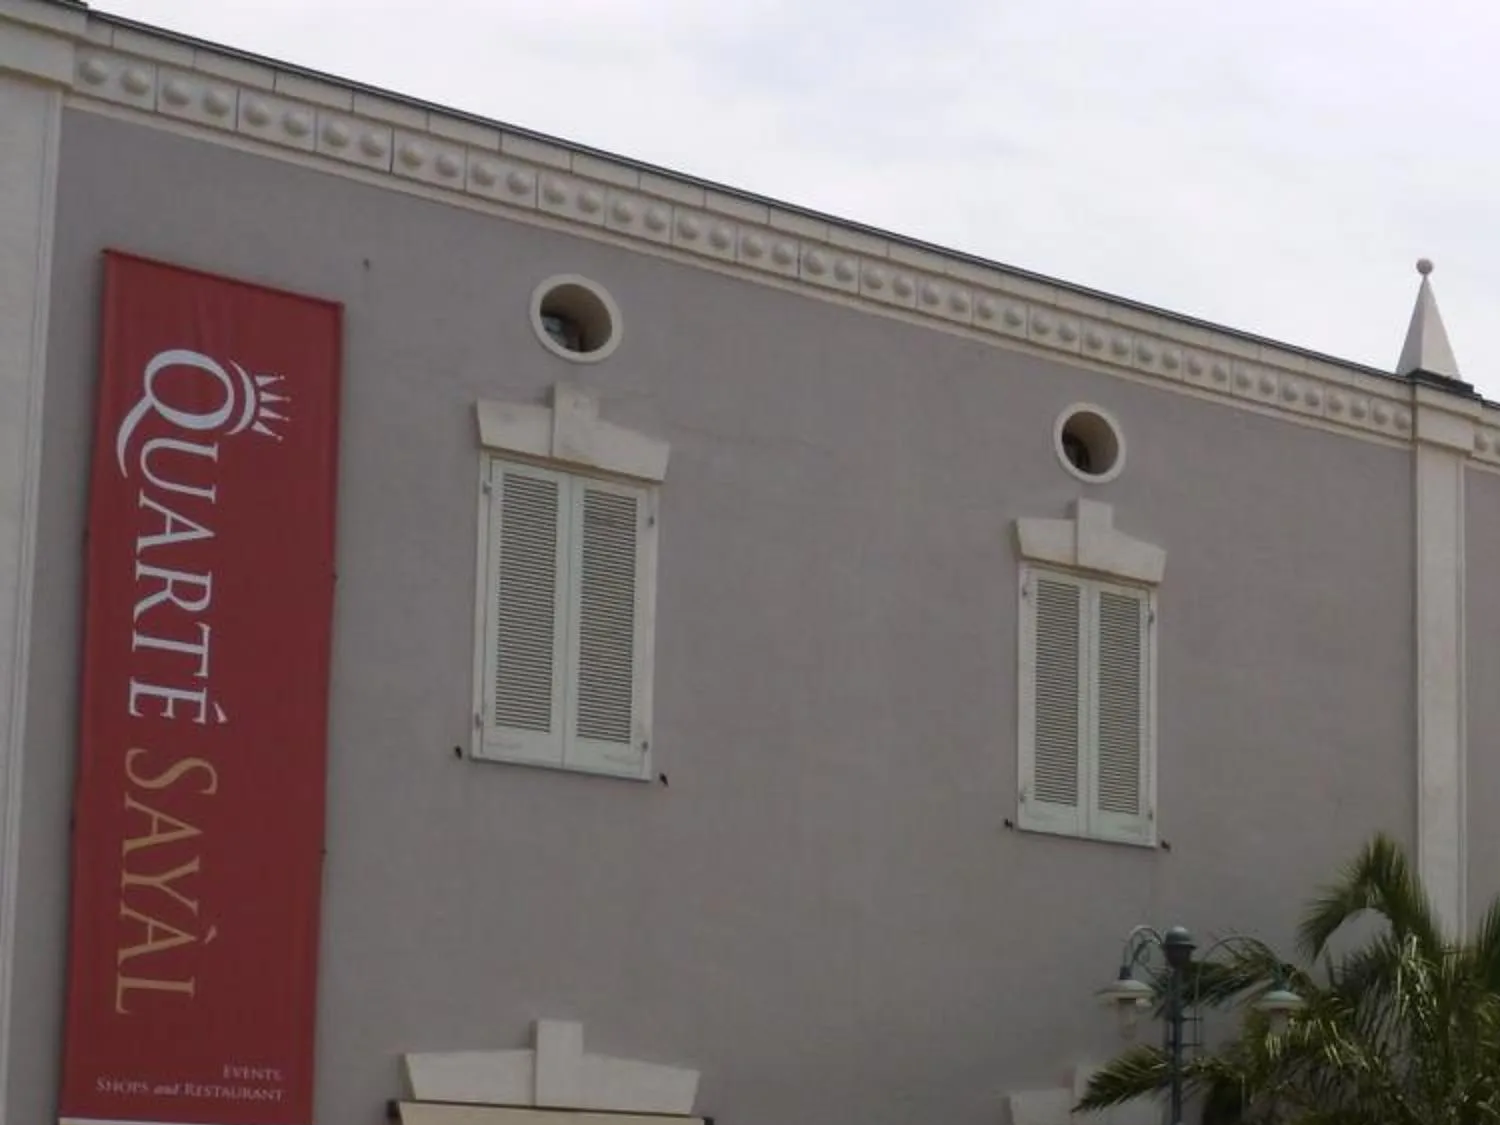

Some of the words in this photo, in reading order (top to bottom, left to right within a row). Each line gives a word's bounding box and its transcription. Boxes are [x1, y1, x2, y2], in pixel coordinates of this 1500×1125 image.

[115, 747, 218, 1014] SAYÀL
[222, 1063, 284, 1081] EVENTS
[96, 1076, 149, 1095] SHOPS
[153, 1083, 180, 1096] and
[184, 1082, 283, 1102] RESTAURANT
